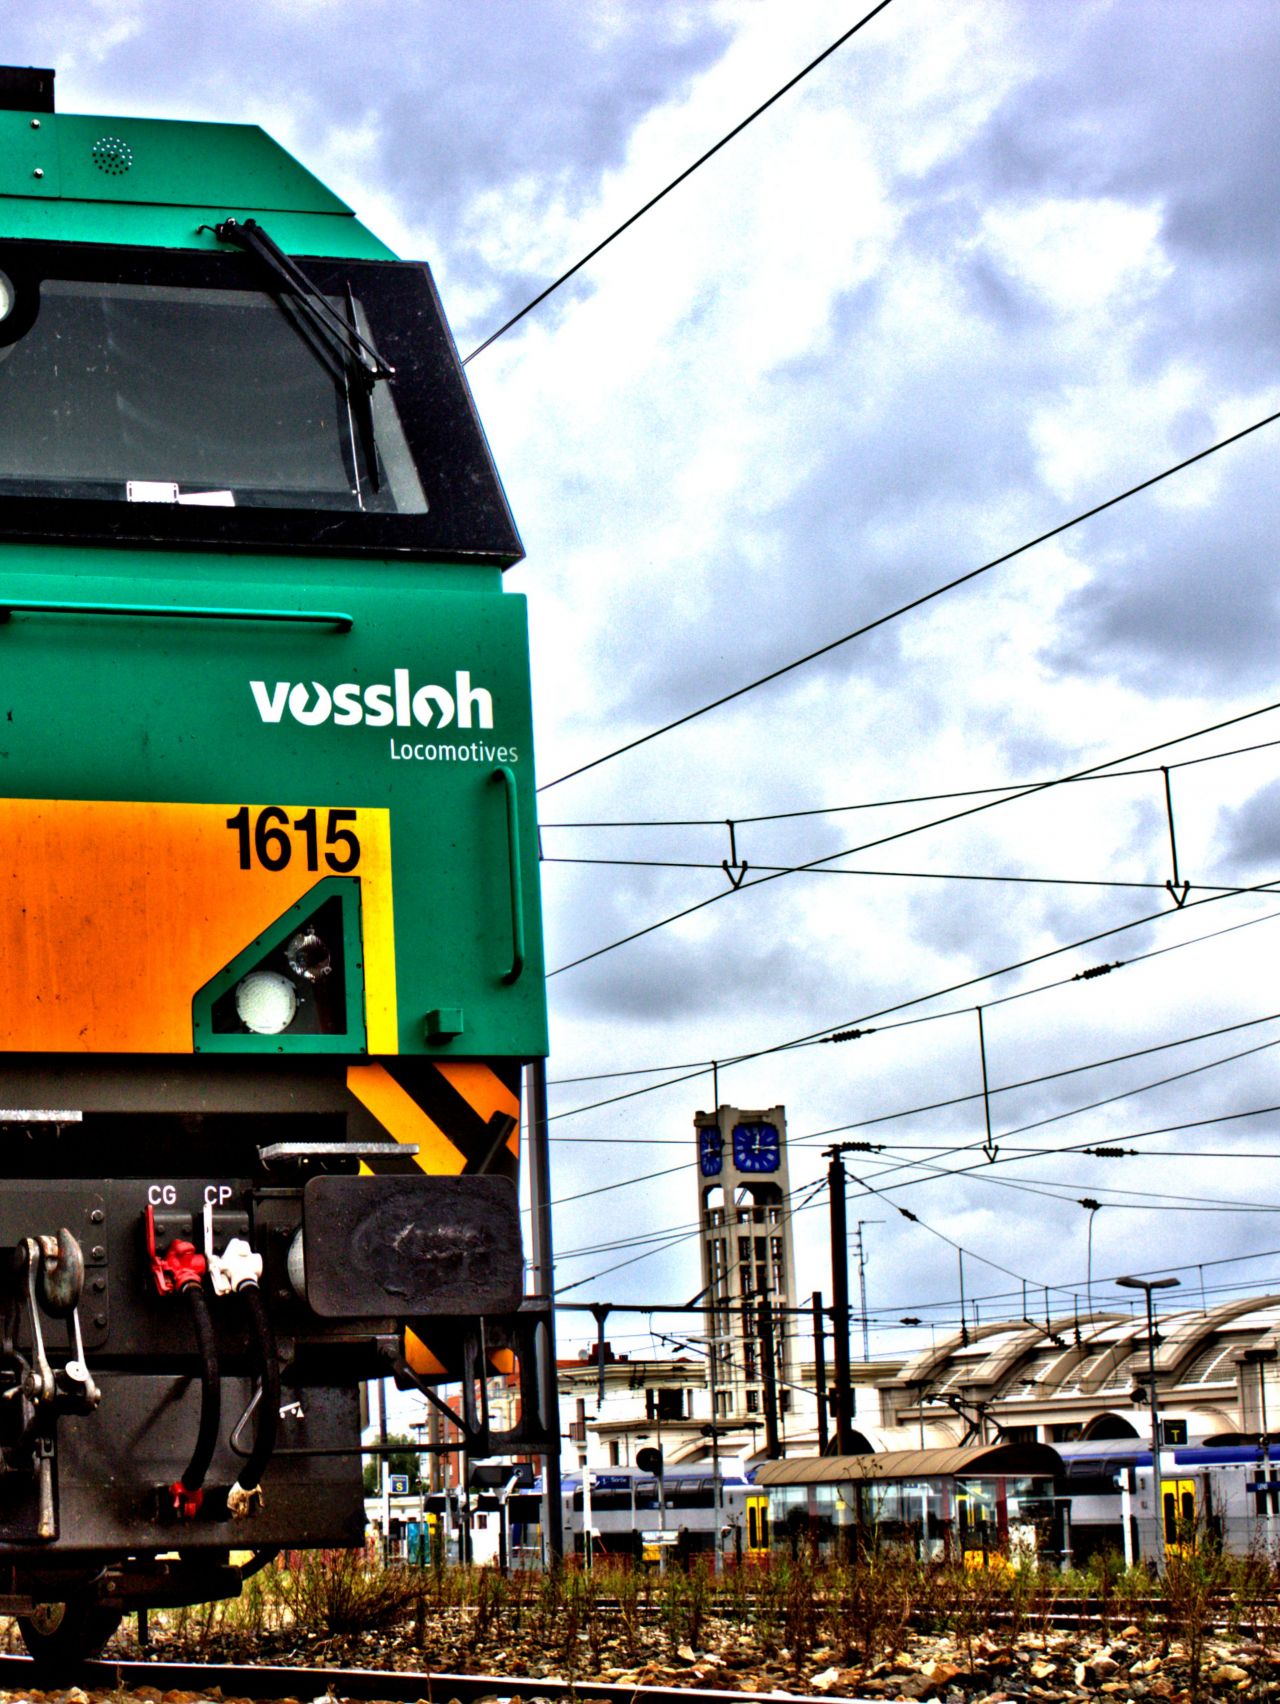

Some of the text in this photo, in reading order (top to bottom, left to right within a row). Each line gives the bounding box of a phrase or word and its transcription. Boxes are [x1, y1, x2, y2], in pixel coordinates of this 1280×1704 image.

[249, 668, 494, 729] vossloh
[389, 738, 519, 763] Locomotives
[226, 806, 361, 874] 1615
[148, 1184, 177, 1205] CG
[204, 1185, 232, 1205] CP
[1171, 1430, 1180, 1442] T
[396, 1482, 403, 1491] S
